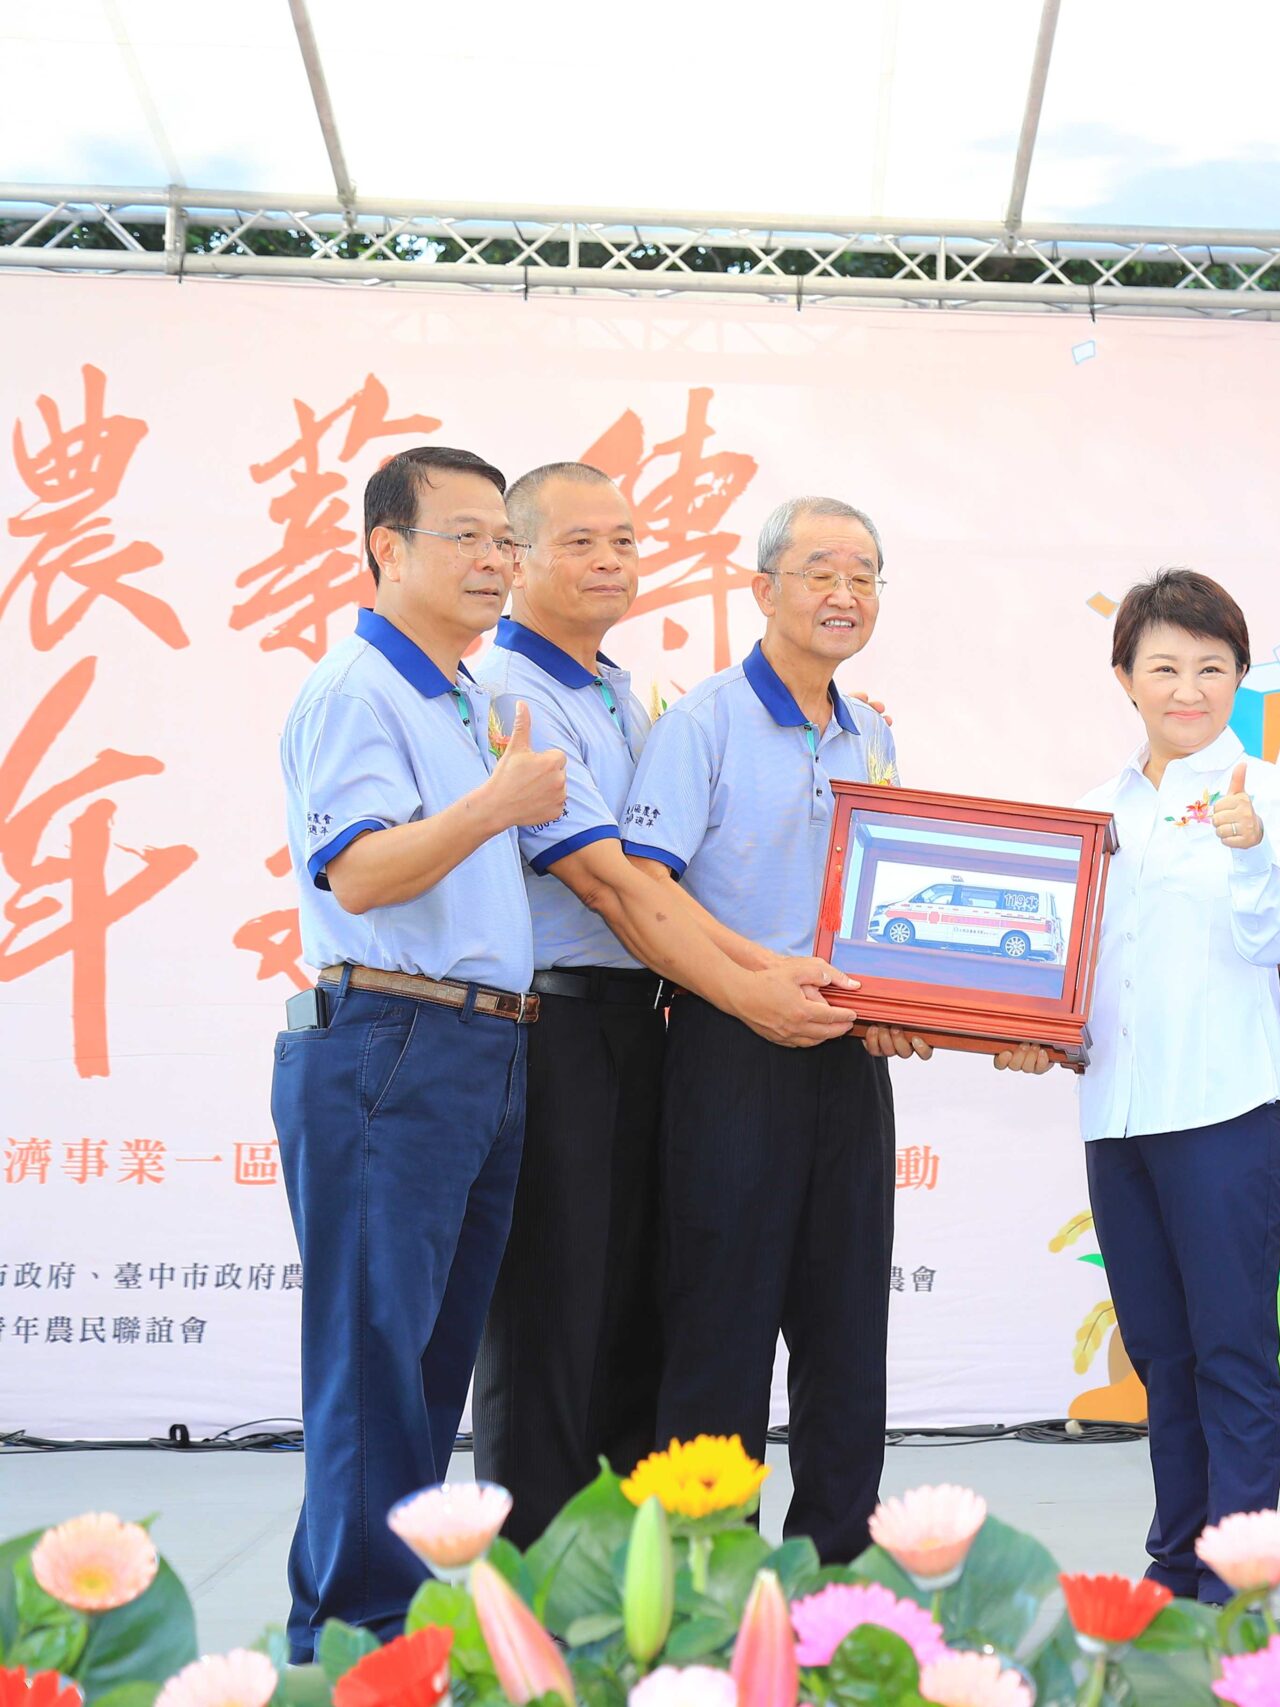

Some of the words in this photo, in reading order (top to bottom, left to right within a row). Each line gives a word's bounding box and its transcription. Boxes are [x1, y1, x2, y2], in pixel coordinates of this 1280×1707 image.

[0, 1261, 303, 1291] 政府、臺中市政府農
[0, 1315, 208, 1345] 年農民聯誼會
